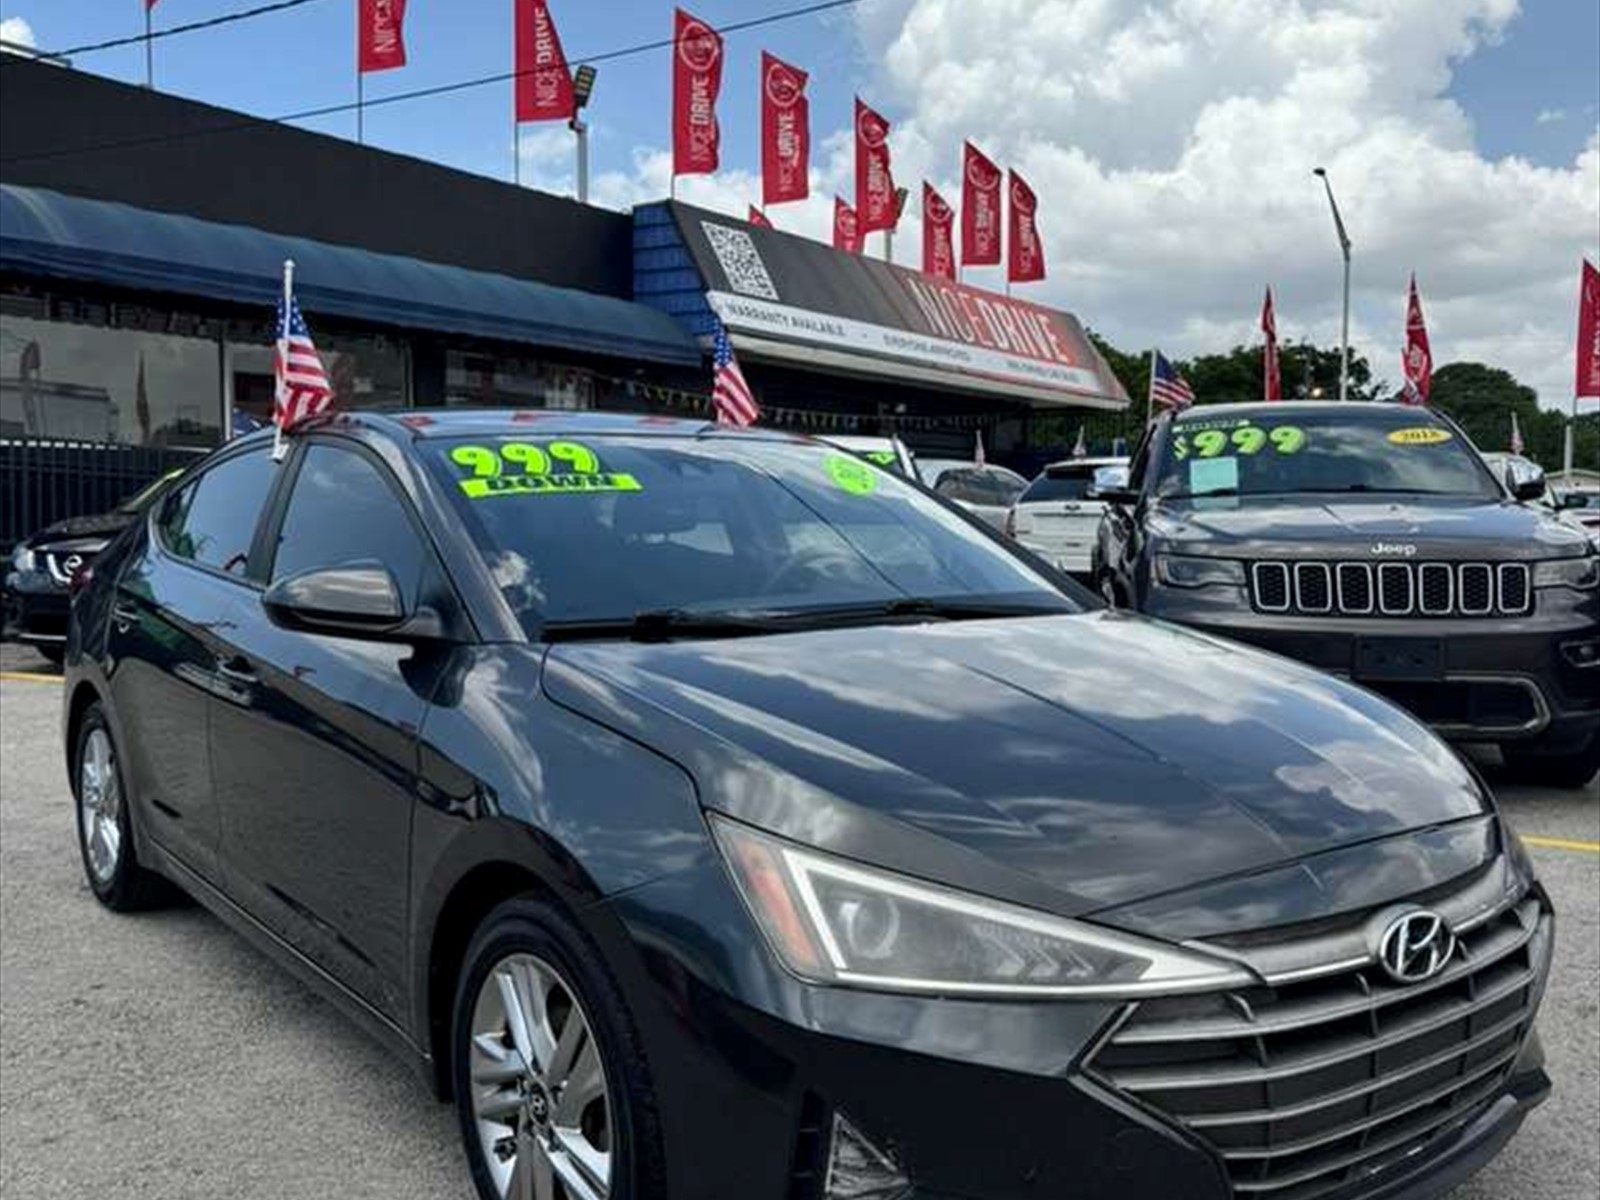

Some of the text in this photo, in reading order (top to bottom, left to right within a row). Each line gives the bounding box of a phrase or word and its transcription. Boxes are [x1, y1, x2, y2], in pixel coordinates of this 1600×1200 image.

[534, 7, 558, 107] NICE DRIVE
[689, 75, 709, 125] DRIVE
[907, 277, 994, 347] NICE
[974, 297, 1071, 364] DRIVE
[451, 441, 599, 478] 999
[486, 475, 612, 490] DOWN
[1370, 541, 1418, 558] Jeep
